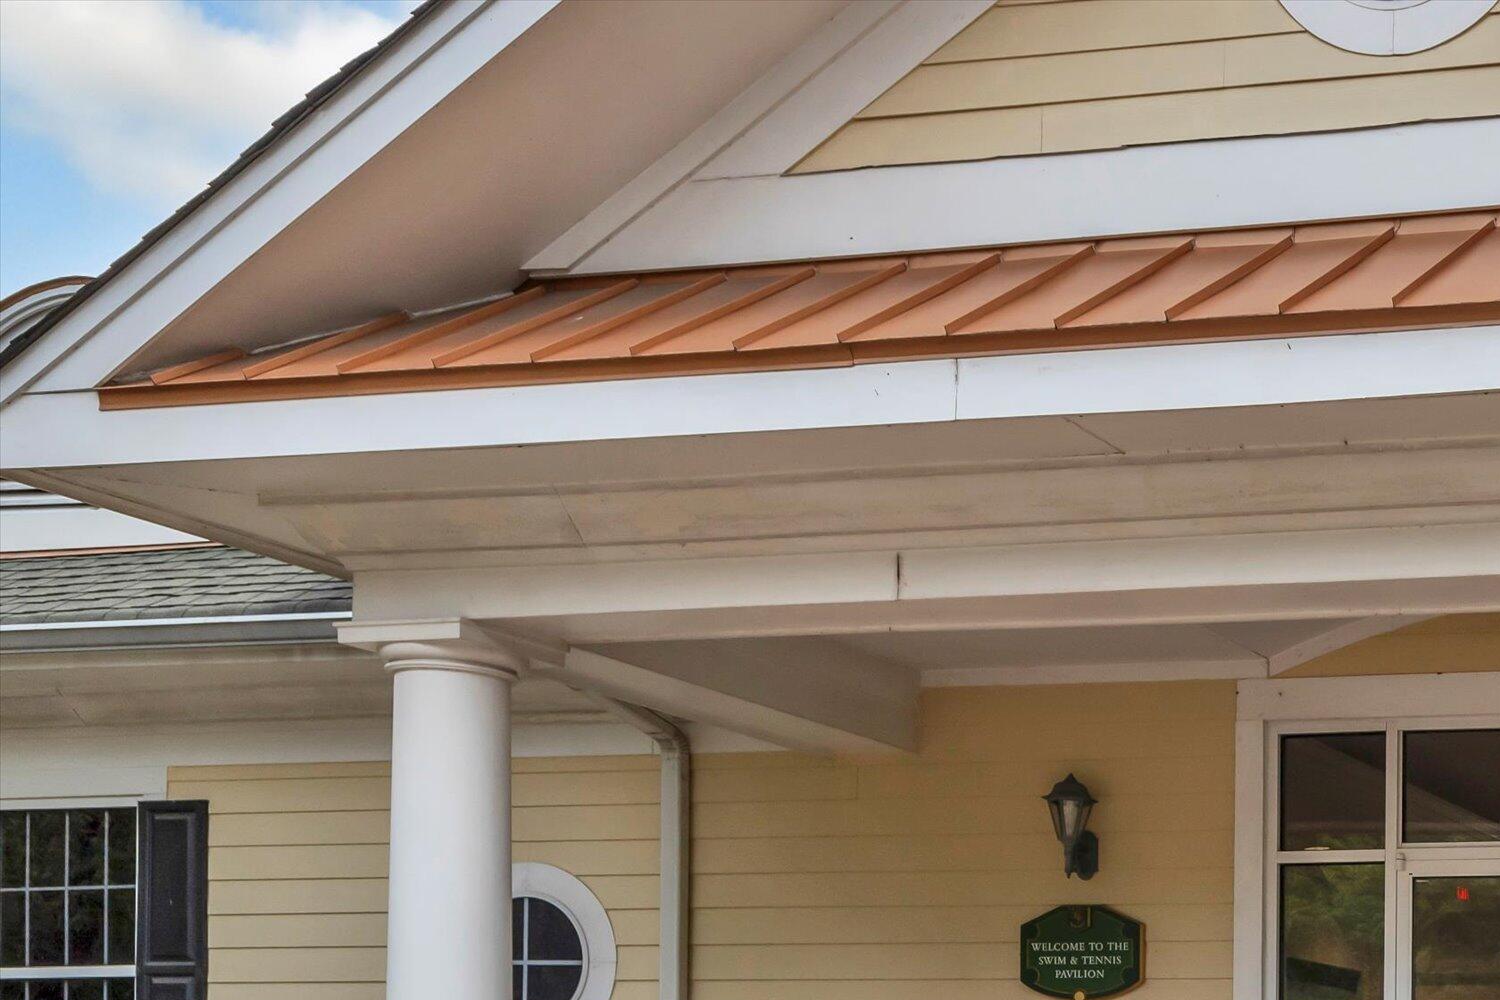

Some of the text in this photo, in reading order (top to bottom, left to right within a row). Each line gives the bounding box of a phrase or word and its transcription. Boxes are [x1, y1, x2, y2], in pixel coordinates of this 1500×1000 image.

[1031, 941, 1129, 951] WELCOME TO THE
[1038, 956, 1122, 966] SWIM & TENNIS
[1055, 969, 1105, 979] PAVILION
